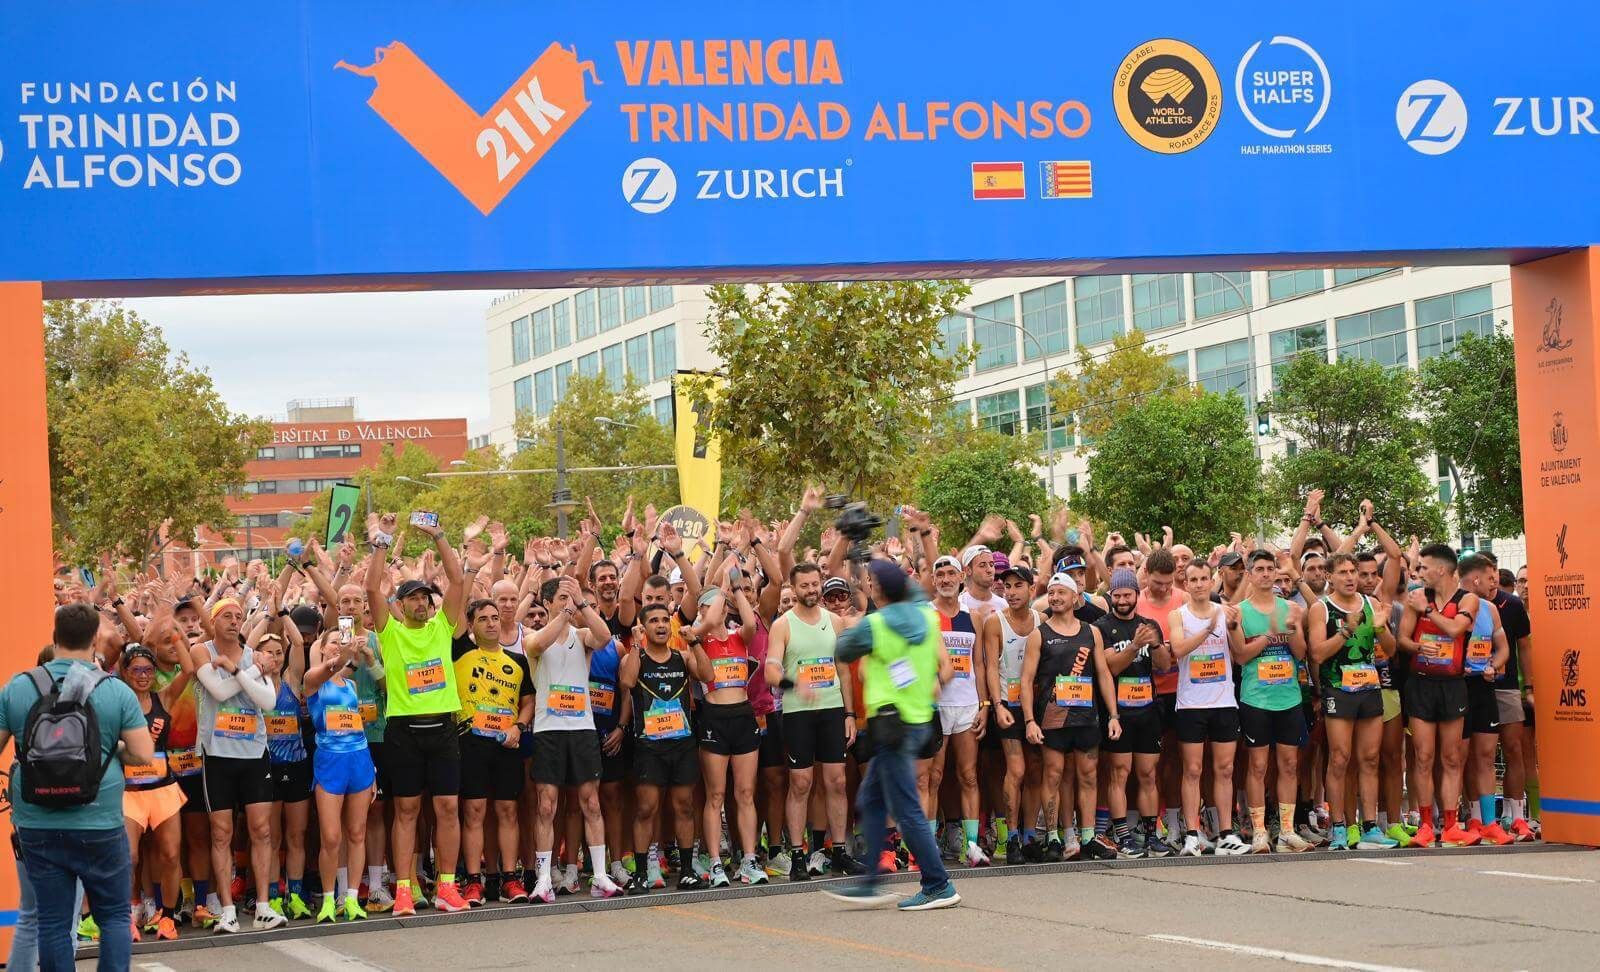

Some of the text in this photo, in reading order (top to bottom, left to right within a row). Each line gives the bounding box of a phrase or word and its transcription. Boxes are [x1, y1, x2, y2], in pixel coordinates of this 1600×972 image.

[615, 39, 843, 86] VALENCIA
[1118, 45, 1156, 88] GOLD LABEL
[1253, 71, 1314, 87] SUPER
[22, 78, 237, 103] FUNDACIÓN
[1253, 87, 1314, 105] HALFS
[1145, 116, 1193, 126] ATHLETICS
[1152, 108, 1185, 117] WORLD
[620, 101, 1092, 142] TRINIDAD ALFONSO
[1169, 95, 1218, 150] ROAD RACE 2025
[20, 113, 240, 148] TRINIDAD
[476, 80, 566, 183] 21K
[1241, 144, 1332, 155] HALF MARATHON SERIES
[24, 153, 241, 189] ALFONSO
[696, 168, 845, 199] ZURICH
[357, 424, 433, 441] VALÈNCIA
[1540, 457, 1581, 471] AJUNTAMENT
[1541, 476, 1549, 487] DE
[331, 503, 352, 544] 2
[1545, 583, 1584, 597] COMUNITAT
[1548, 597, 1590, 611] DE L'ESPORT
[1560, 689, 1586, 706] AIMS
[35, 785, 81, 795] new balance
